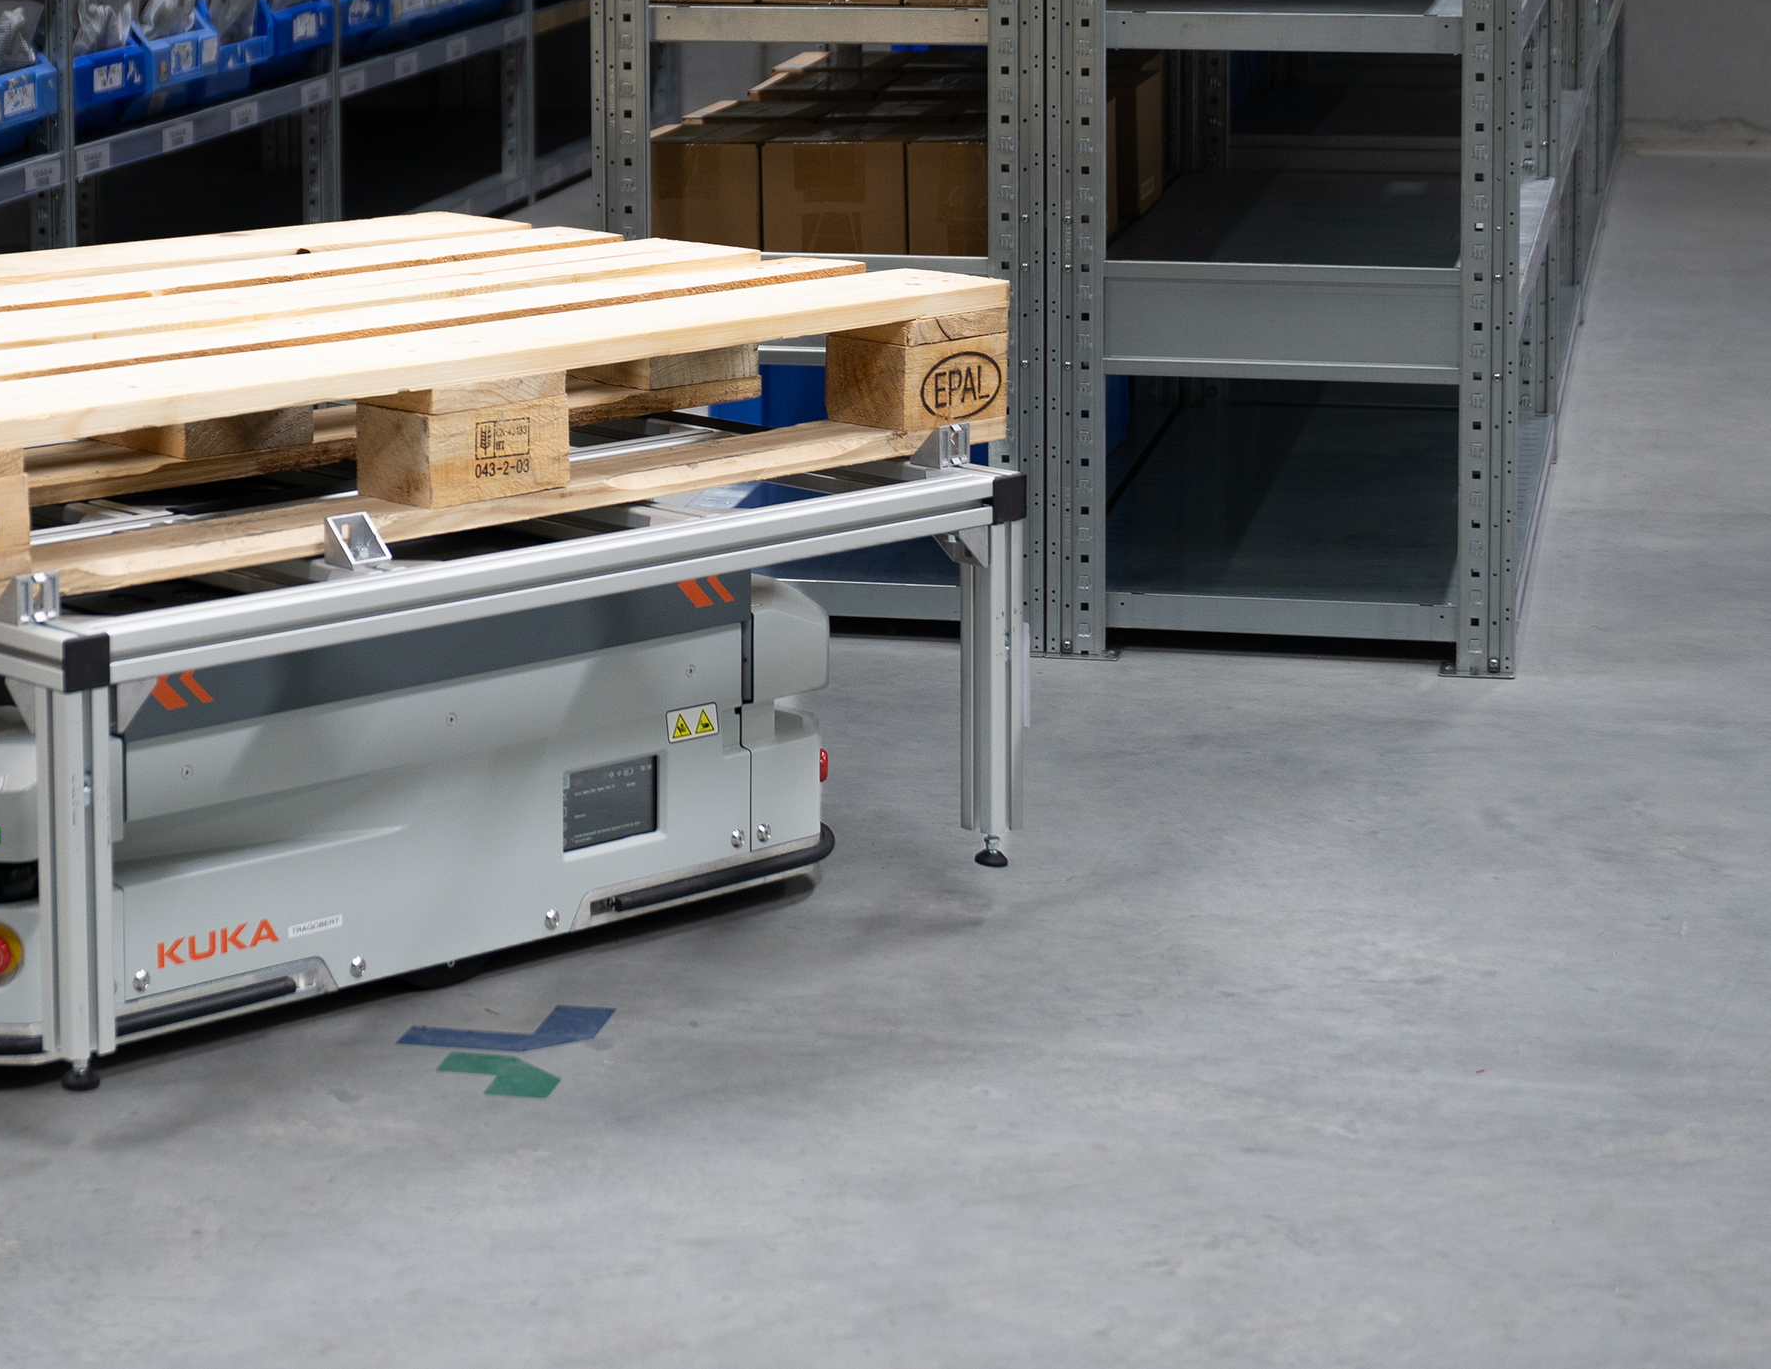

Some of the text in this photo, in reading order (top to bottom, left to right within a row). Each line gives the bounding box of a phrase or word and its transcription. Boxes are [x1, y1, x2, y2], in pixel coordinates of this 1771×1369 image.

[935, 365, 990, 409] EPAL
[475, 458, 529, 478] 043-2-03
[291, 916, 340, 935] TRAGOBERT
[157, 918, 279, 969] KUKA
